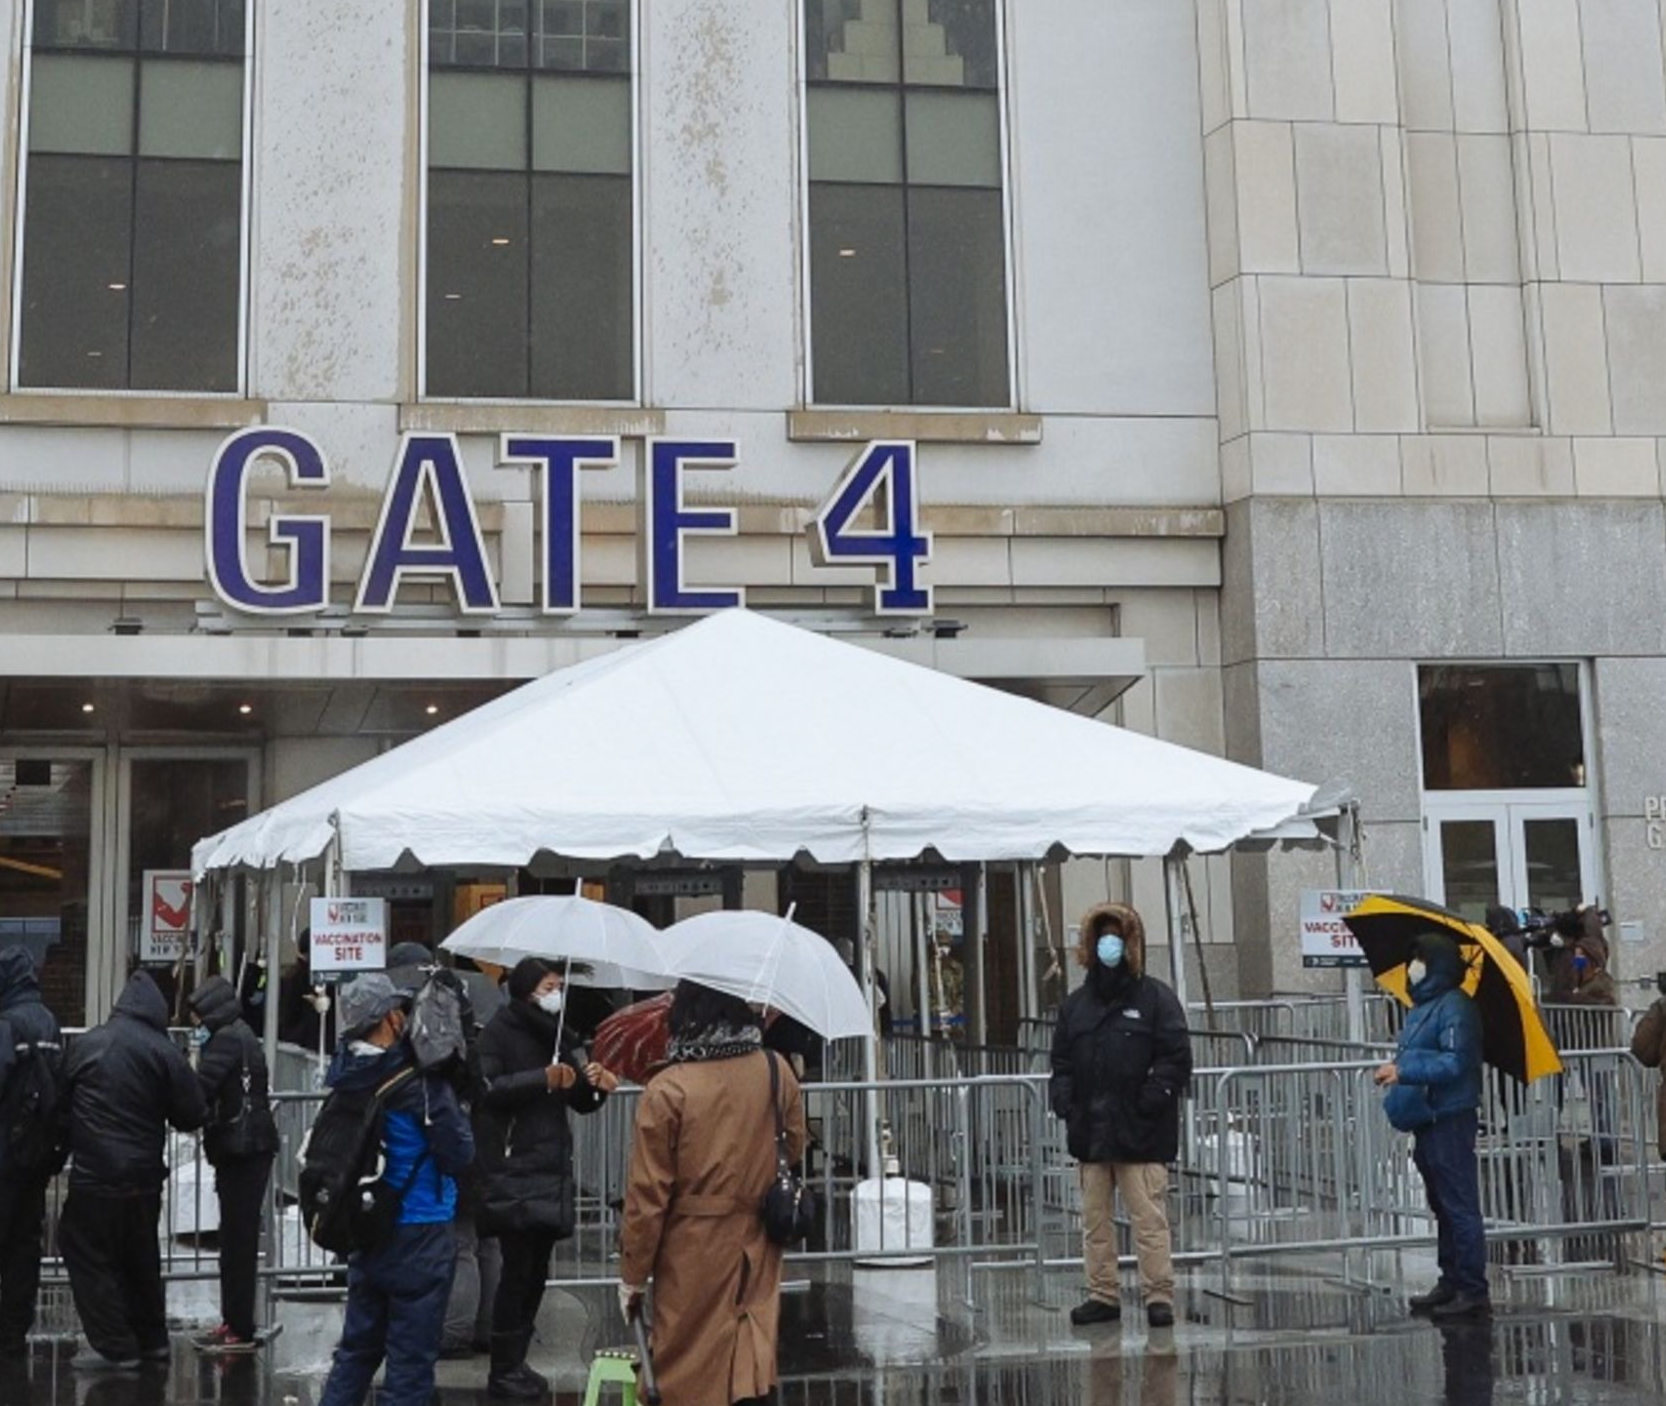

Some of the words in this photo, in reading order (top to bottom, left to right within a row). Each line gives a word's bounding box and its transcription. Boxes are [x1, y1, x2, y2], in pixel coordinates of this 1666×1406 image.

[206, 425, 744, 615] GATE
[811, 439, 932, 615] 4
[314, 933, 382, 946] VACCINATION
[335, 947, 362, 961] SITE
